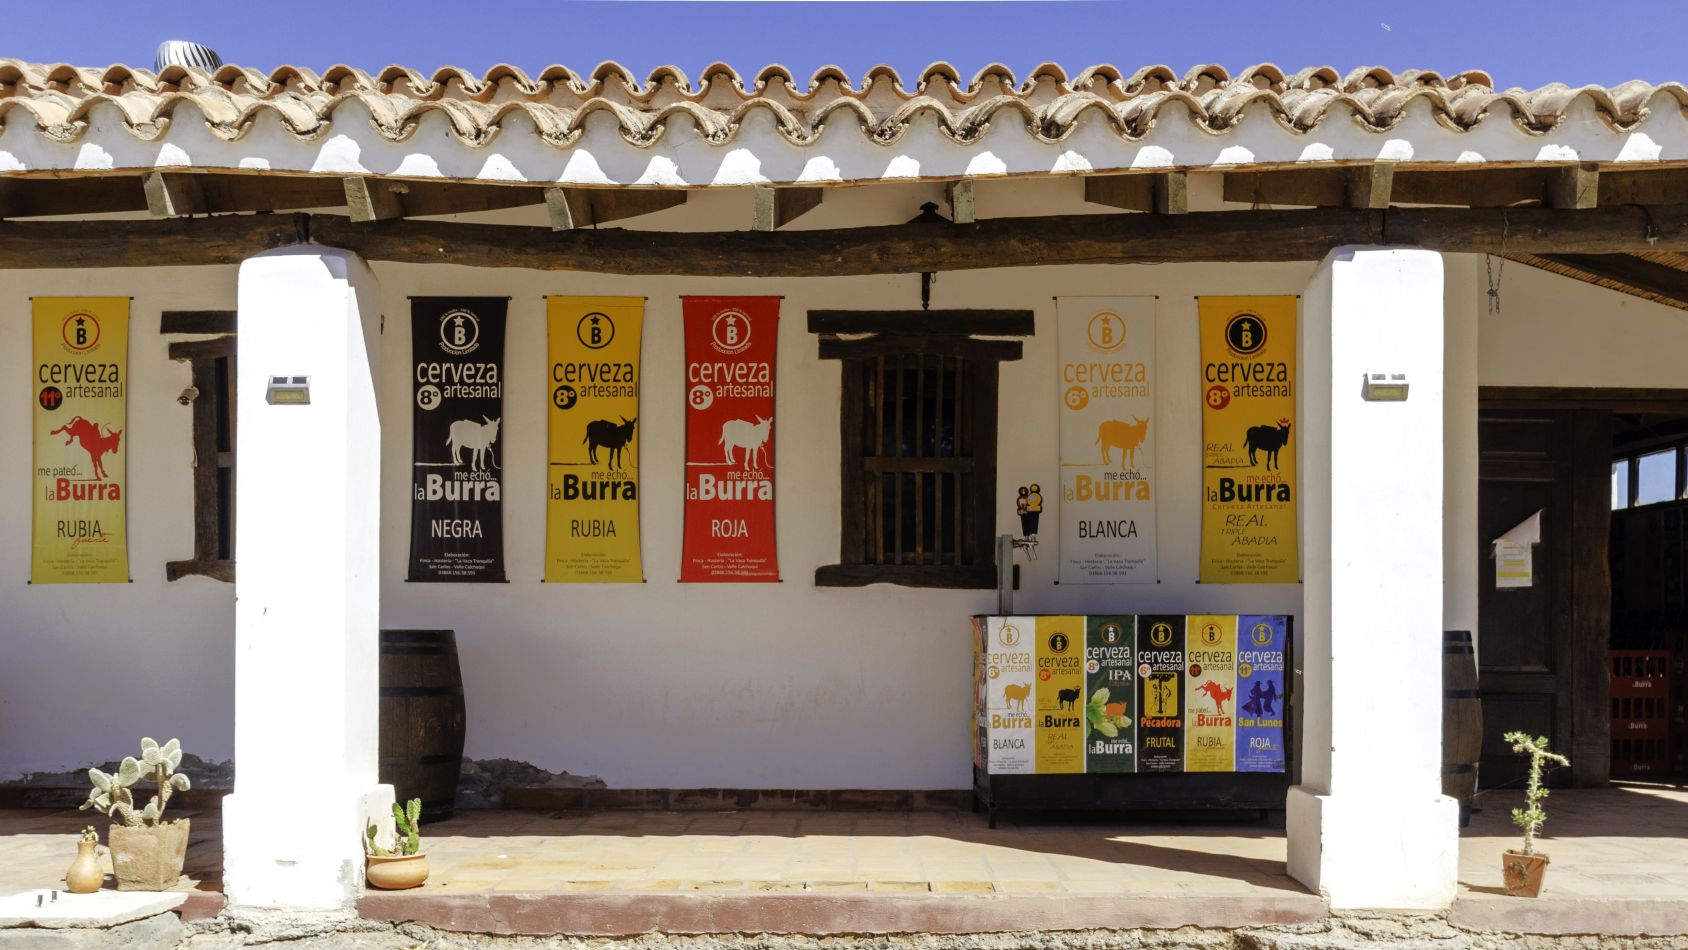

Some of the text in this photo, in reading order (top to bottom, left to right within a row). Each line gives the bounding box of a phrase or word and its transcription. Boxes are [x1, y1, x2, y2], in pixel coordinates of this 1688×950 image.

[76, 328, 87, 345] B
[454, 327, 466, 345] B
[591, 327, 602, 344] B
[726, 326, 738, 344] B
[1101, 327, 1113, 345] B
[1241, 331, 1252, 348] B
[39, 363, 119, 383] cerveza
[417, 362, 498, 383] cerveza
[553, 362, 634, 383] cerveza
[688, 362, 770, 383] cerveza
[1063, 362, 1146, 383] cerveza
[1205, 362, 1287, 383] cerveza
[65, 382, 123, 398] artesanal
[443, 381, 501, 398] artesanal
[580, 381, 638, 398] artesanal
[716, 380, 774, 398] artesanal
[1091, 381, 1150, 398] artesanal
[1233, 380, 1292, 397] artesanal
[420, 390, 439, 405] 8°
[692, 389, 711, 406] 8°
[1206, 443, 1236, 452] REAL
[38, 467, 51, 476] me
[454, 471, 468, 481] me
[591, 471, 605, 480] me
[727, 471, 740, 480] me
[1104, 471, 1118, 481] me
[1246, 474, 1260, 483] me
[56, 478, 121, 501] Burra
[426, 474, 500, 501] Burra
[563, 474, 637, 500] Burra
[699, 473, 773, 501] Burra
[1076, 474, 1151, 501] Burra
[1207, 477, 1291, 502] la Burra
[1225, 513, 1268, 527] REAL
[57, 520, 103, 538] RUBIA
[431, 520, 483, 538] NEGRA
[571, 520, 616, 538] RUBIA
[711, 520, 749, 538] ROJA
[1078, 520, 1138, 538] BLANCA
[1108, 632, 1116, 642] B
[1208, 631, 1215, 642] B
[987, 652, 1031, 665] cerveza
[1087, 646, 1130, 659] cerveza
[1138, 650, 1182, 663] cerveza
[1188, 650, 1232, 663] cerveza
[1238, 650, 1283, 663] cerveza
[1001, 664, 1033, 673] artesanal
[1038, 656, 1080, 668] cerveza
[1101, 657, 1133, 667] artesanal
[1152, 661, 1185, 671] artesanal
[1203, 661, 1234, 671] artesanal
[1253, 661, 1285, 671] artesanal
[1052, 666, 1082, 675] artesanal
[1108, 669, 1133, 681] IPA
[992, 714, 1032, 729] Burra
[1044, 715, 1080, 728] Burra
[1140, 716, 1182, 728] Pecadora
[1197, 713, 1232, 727] Burra
[1238, 717, 1283, 727] San Lunes
[993, 738, 1025, 750] BLANCA
[1096, 740, 1133, 754] Burra
[1146, 736, 1176, 748] FRUTAL
[1197, 736, 1222, 747] RUBIA
[1250, 737, 1271, 748] ROJA
